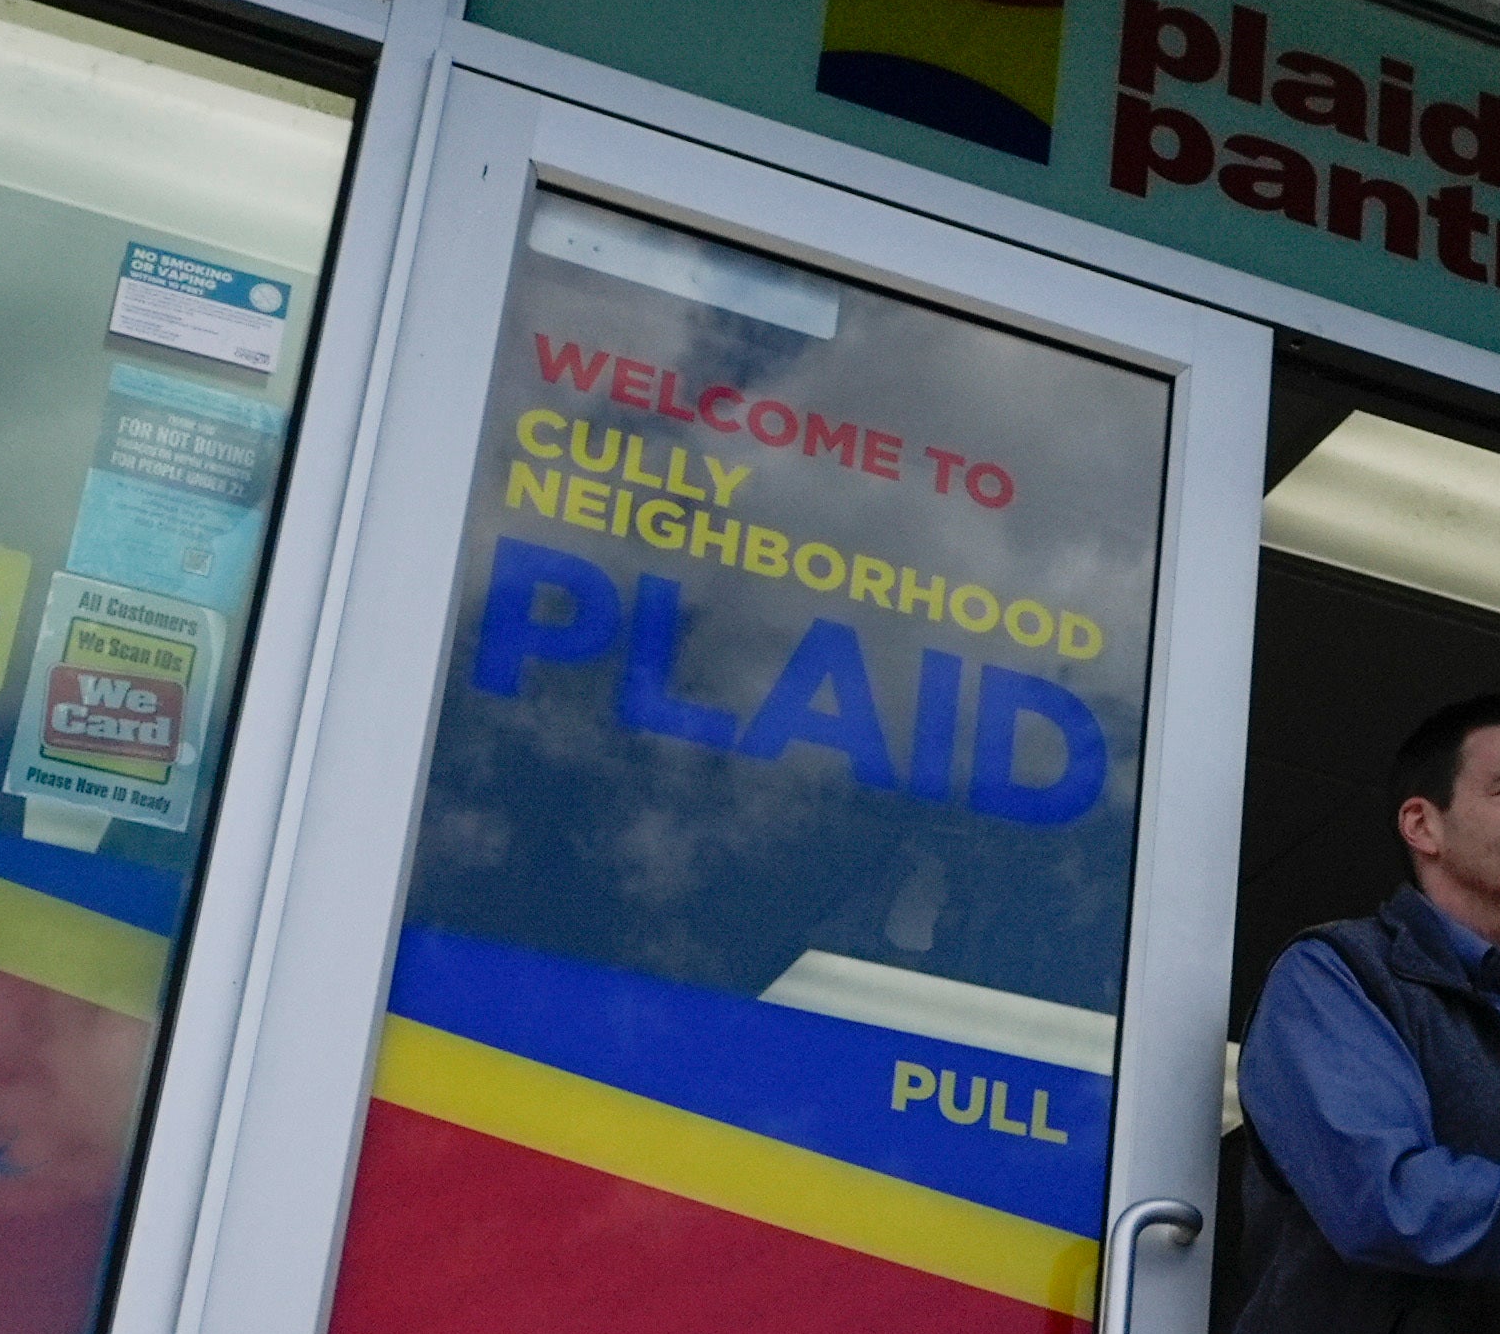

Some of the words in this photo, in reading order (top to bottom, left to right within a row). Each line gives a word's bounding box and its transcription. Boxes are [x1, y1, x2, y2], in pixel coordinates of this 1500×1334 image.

[131, 260, 155, 274] OR
[157, 266, 217, 290] VAPING
[133, 249, 157, 263] NO
[160, 255, 233, 283] SMOKING
[118, 416, 153, 440] FOR
[156, 425, 191, 449] NOT
[194, 436, 256, 467] BUYING
[535, 332, 903, 482] WELCOME
[926, 444, 1016, 512] TO
[514, 407, 753, 510] CULLY
[504, 460, 1104, 662] NEIGHBORHOOD
[78, 591, 101, 612] All
[107, 597, 198, 636] Customers
[77, 630, 104, 653] We
[108, 638, 150, 665] Scan
[154, 648, 183, 672] IDs
[78, 673, 159, 714] We
[470, 534, 1112, 829] PLAID
[51, 702, 171, 747] Card
[26, 766, 72, 791] Please
[76, 777, 109, 799] Have
[112, 785, 128, 802] ID
[130, 789, 171, 814] Ready
[889, 1058, 1069, 1147] PULL
